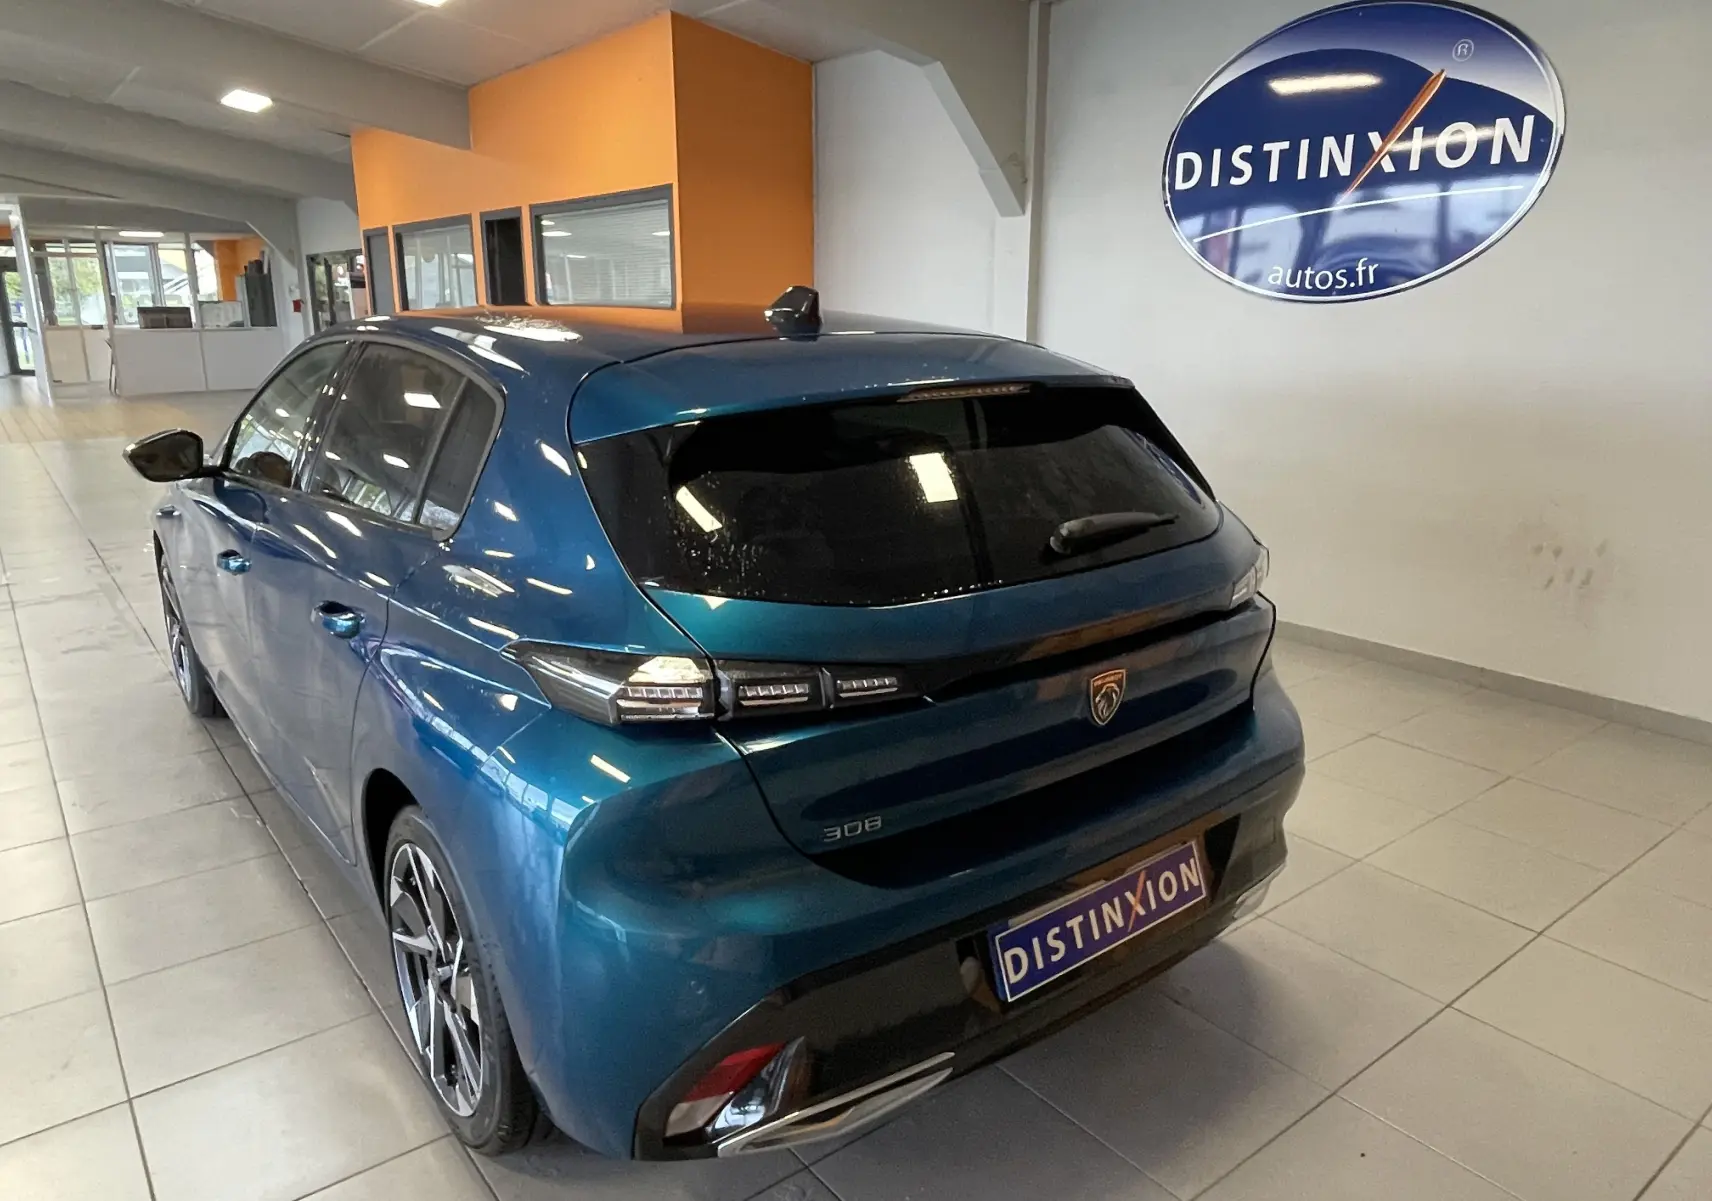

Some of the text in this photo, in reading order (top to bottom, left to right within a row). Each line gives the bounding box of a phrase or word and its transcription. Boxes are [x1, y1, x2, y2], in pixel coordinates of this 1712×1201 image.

[1174, 115, 1535, 203] DISTINXION
[1268, 257, 1380, 291] autos.fr
[823, 815, 882, 842] 308
[1003, 857, 1201, 985] DISTINXION
